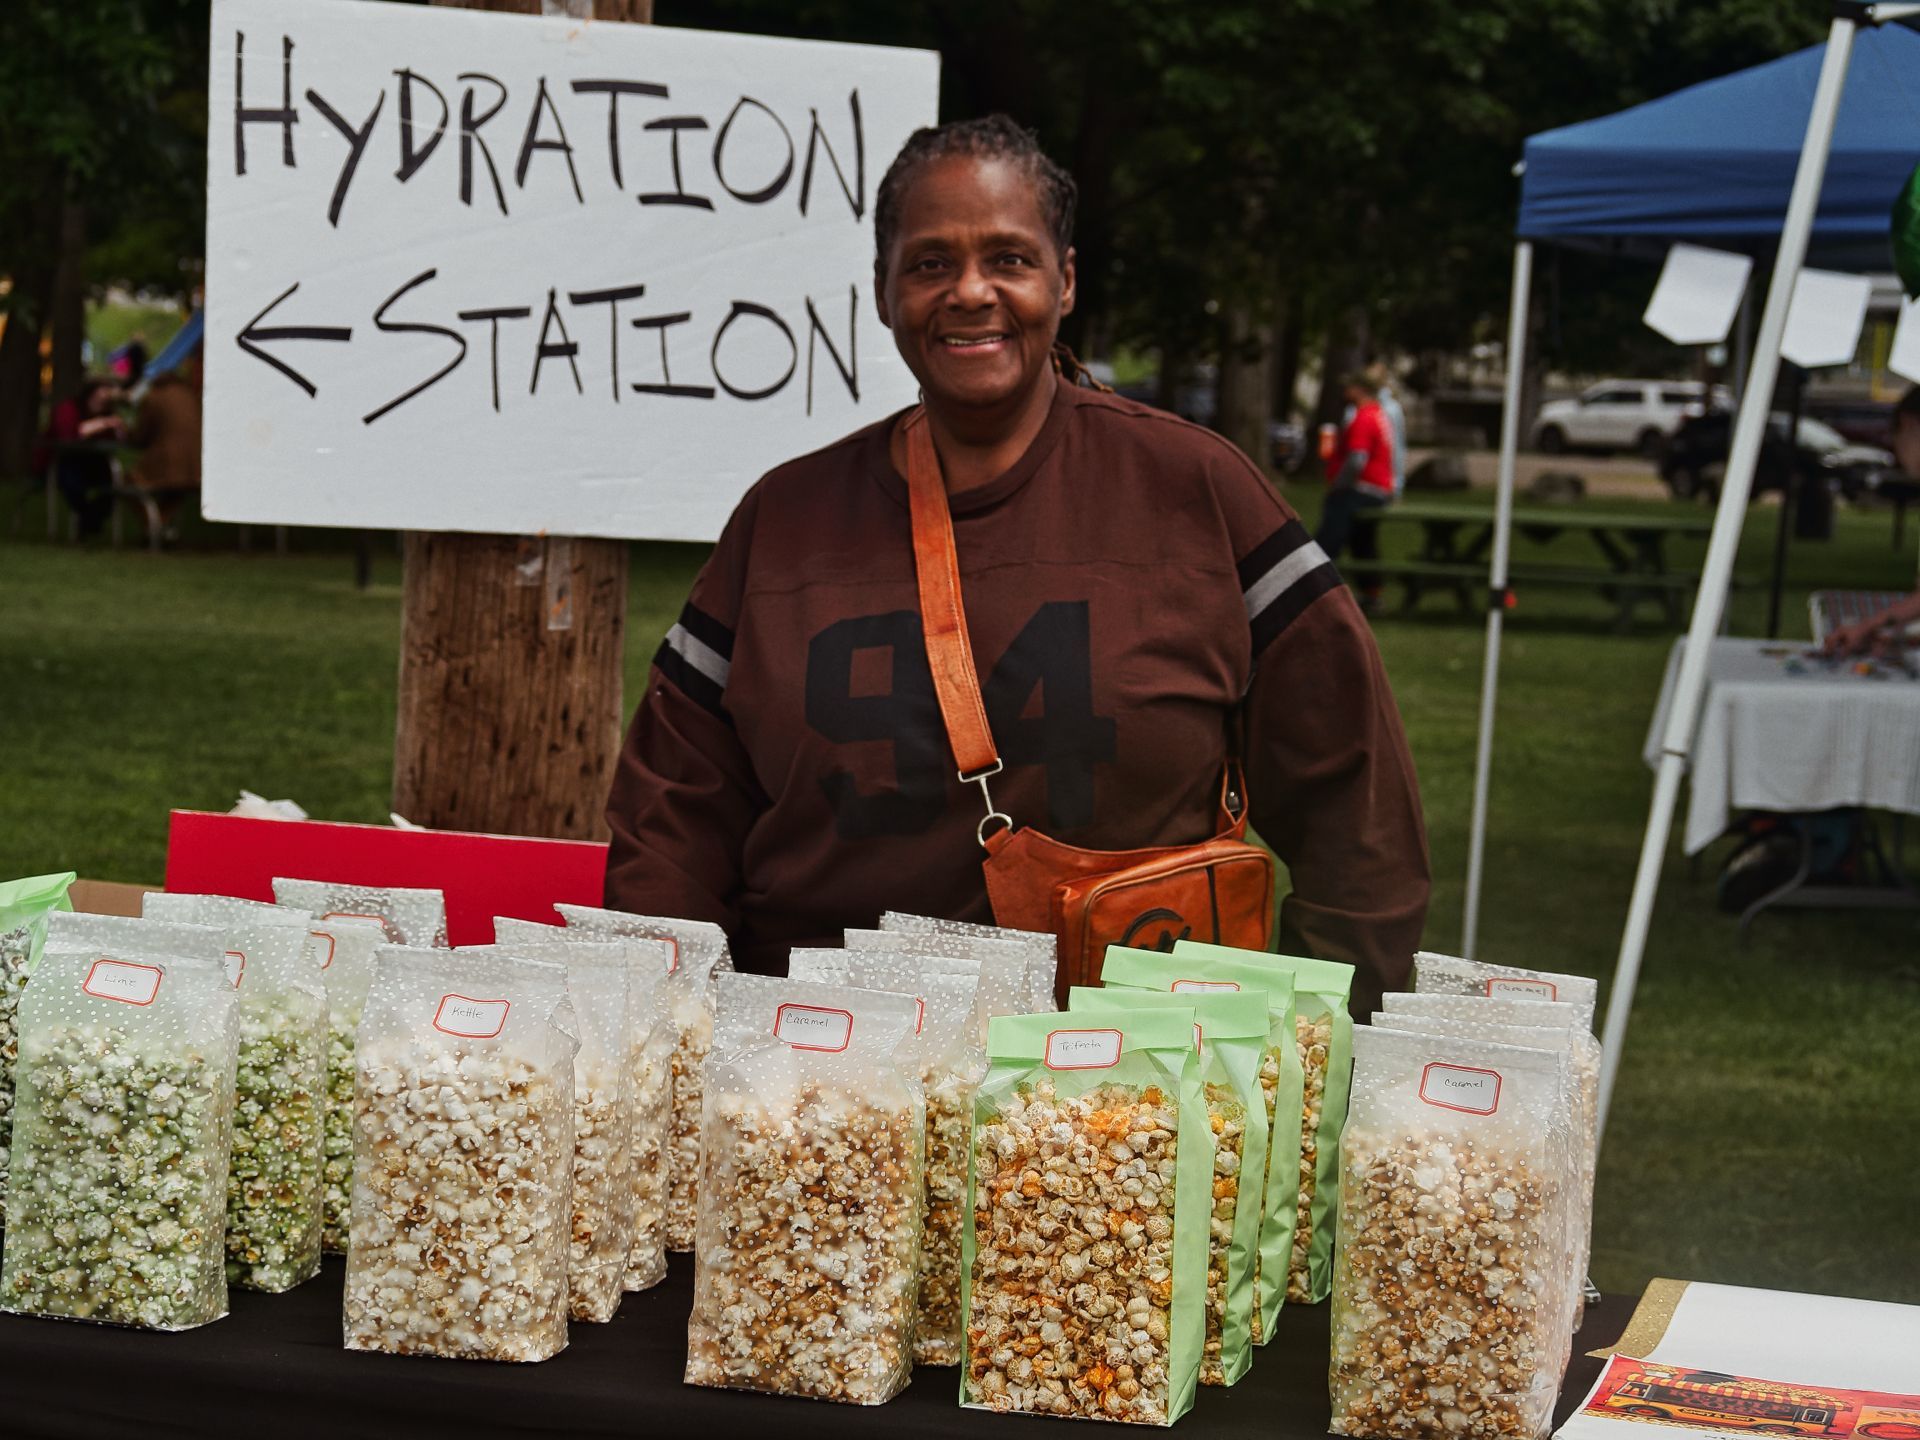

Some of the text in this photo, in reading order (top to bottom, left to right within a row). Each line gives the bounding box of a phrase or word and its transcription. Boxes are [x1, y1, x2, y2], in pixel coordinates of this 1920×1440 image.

[362, 268, 860, 425] STATION
[805, 600, 1118, 840] 94
[450, 1005, 485, 1019] Kettle
[785, 1012, 829, 1028] Caramel
